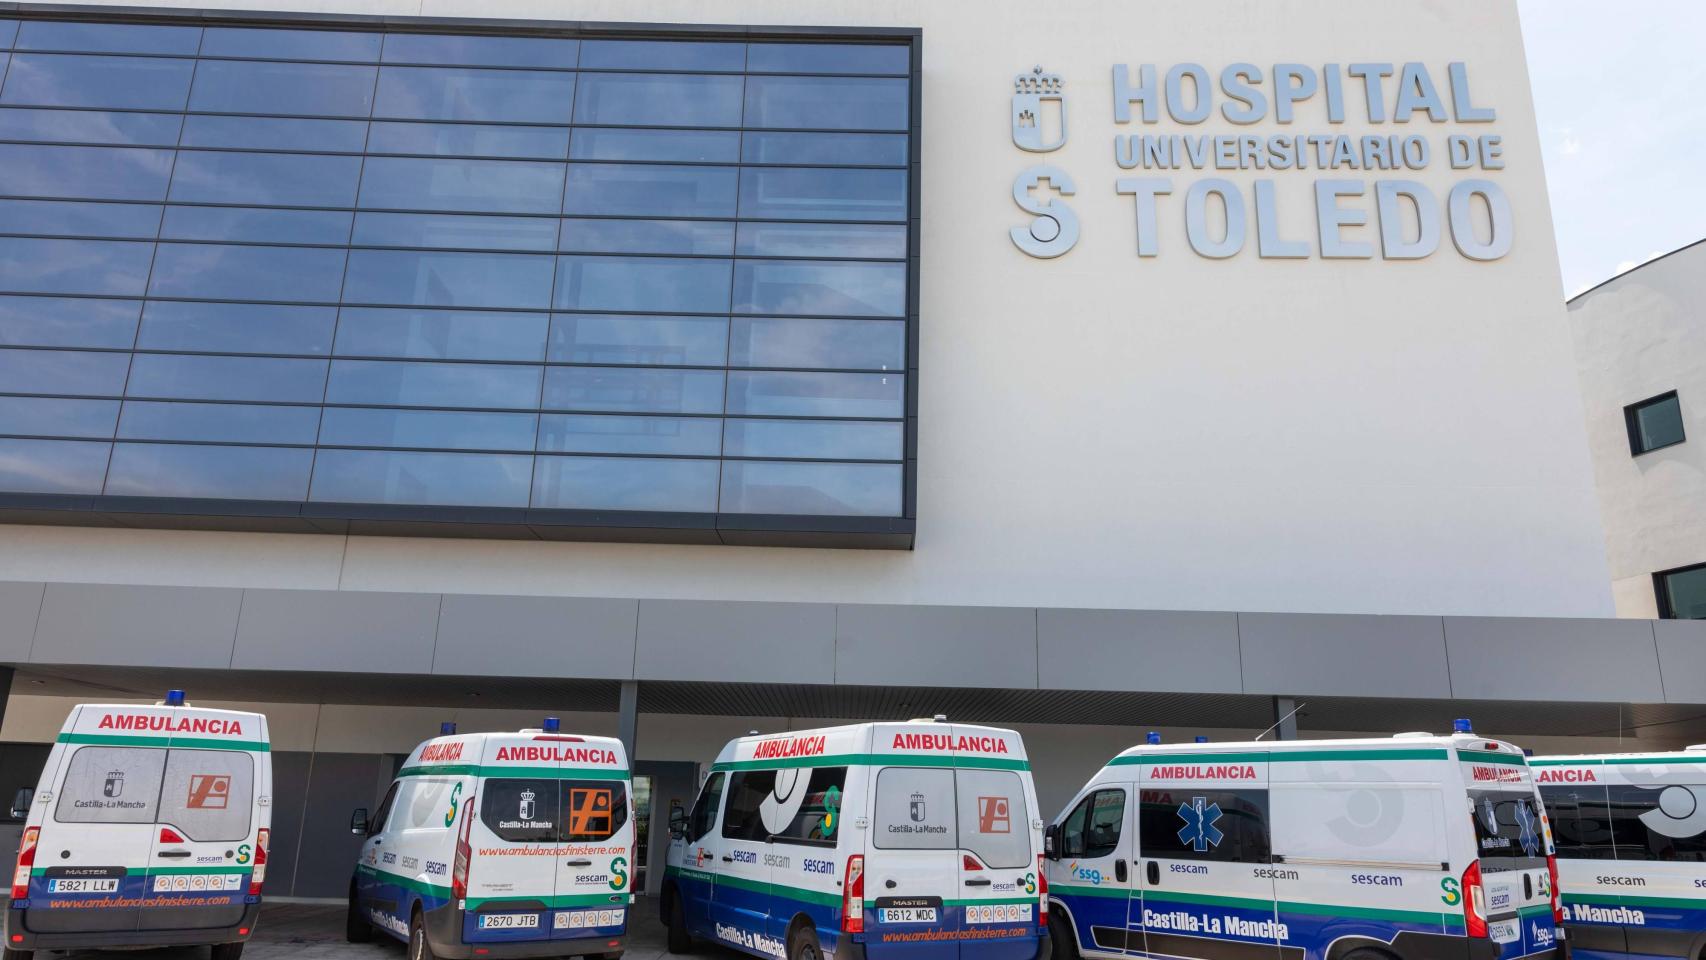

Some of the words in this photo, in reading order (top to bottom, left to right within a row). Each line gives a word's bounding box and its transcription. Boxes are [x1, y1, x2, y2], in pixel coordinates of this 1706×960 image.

[1112, 62, 1497, 125] HOSPITAL
[1114, 134, 1431, 171] UNIVERSITARIO
[1447, 134, 1506, 171] DE
[1115, 178, 1515, 261] TOLEDO
[98, 714, 243, 735] AMBULANCIA
[753, 736, 825, 759] AMBULANCIA
[892, 733, 1009, 754] AMBULANCIA
[495, 746, 618, 765] AMBULANCIA
[1150, 766, 1256, 779] AMBULANCIA
[1536, 769, 1597, 783] ANCIA
[478, 844, 626, 856] www.ambulanciasfinisterre.com
[733, 849, 757, 864] sescam
[425, 860, 447, 876] sescam
[763, 853, 791, 869] sescam
[803, 858, 835, 875] sescam
[1170, 863, 1208, 875] sescam
[1253, 867, 1299, 881] sescam
[575, 873, 608, 882] sescam
[1351, 874, 1403, 887] sescam
[1596, 875, 1646, 887] sescam
[58, 881, 87, 891] 5821
[93, 880, 116, 891] LLW
[50, 894, 231, 909] www.ambulanciasfinisterre.com
[486, 916, 513, 927] 2670
[517, 915, 537, 926] JTB
[887, 909, 912, 920] 6612
[916, 909, 934, 920] MDC
[1573, 903, 1646, 925] Mancha
[1143, 909, 1221, 934] Castilla-La
[1224, 915, 1289, 940] Mancha
[882, 927, 1027, 942] www.ambulanciasfinisterre.com
[753, 933, 787, 958] Mancha
